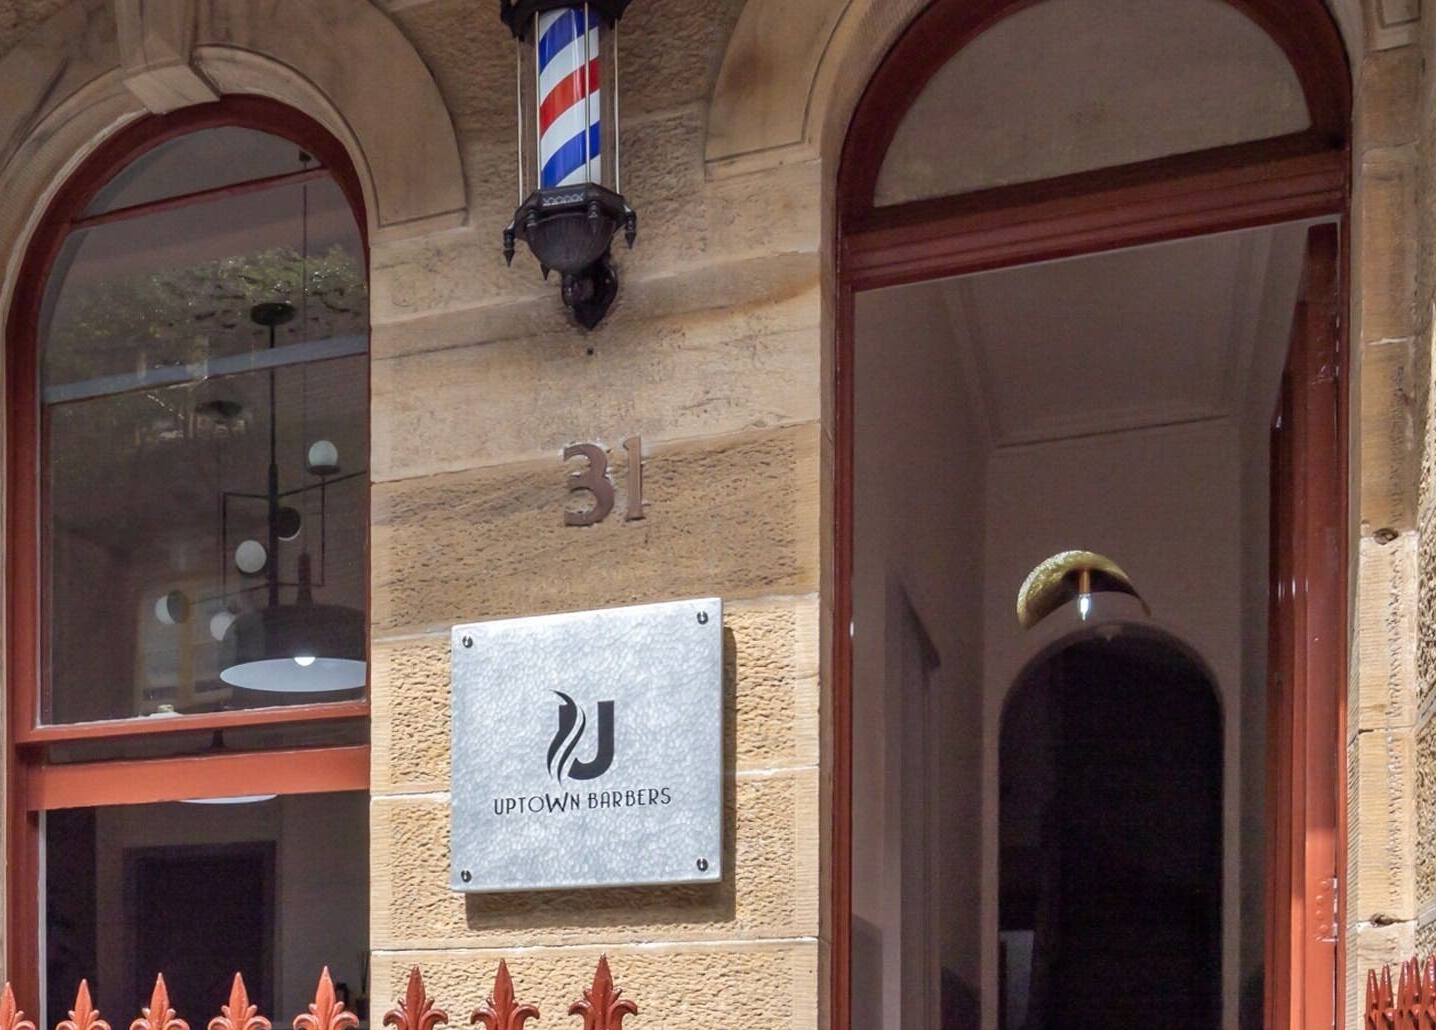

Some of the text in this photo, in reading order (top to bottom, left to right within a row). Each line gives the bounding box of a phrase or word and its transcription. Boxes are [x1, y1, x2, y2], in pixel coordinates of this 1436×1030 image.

[563, 435, 646, 527] 31
[494, 787, 672, 816] UPTOWN BARBERS
